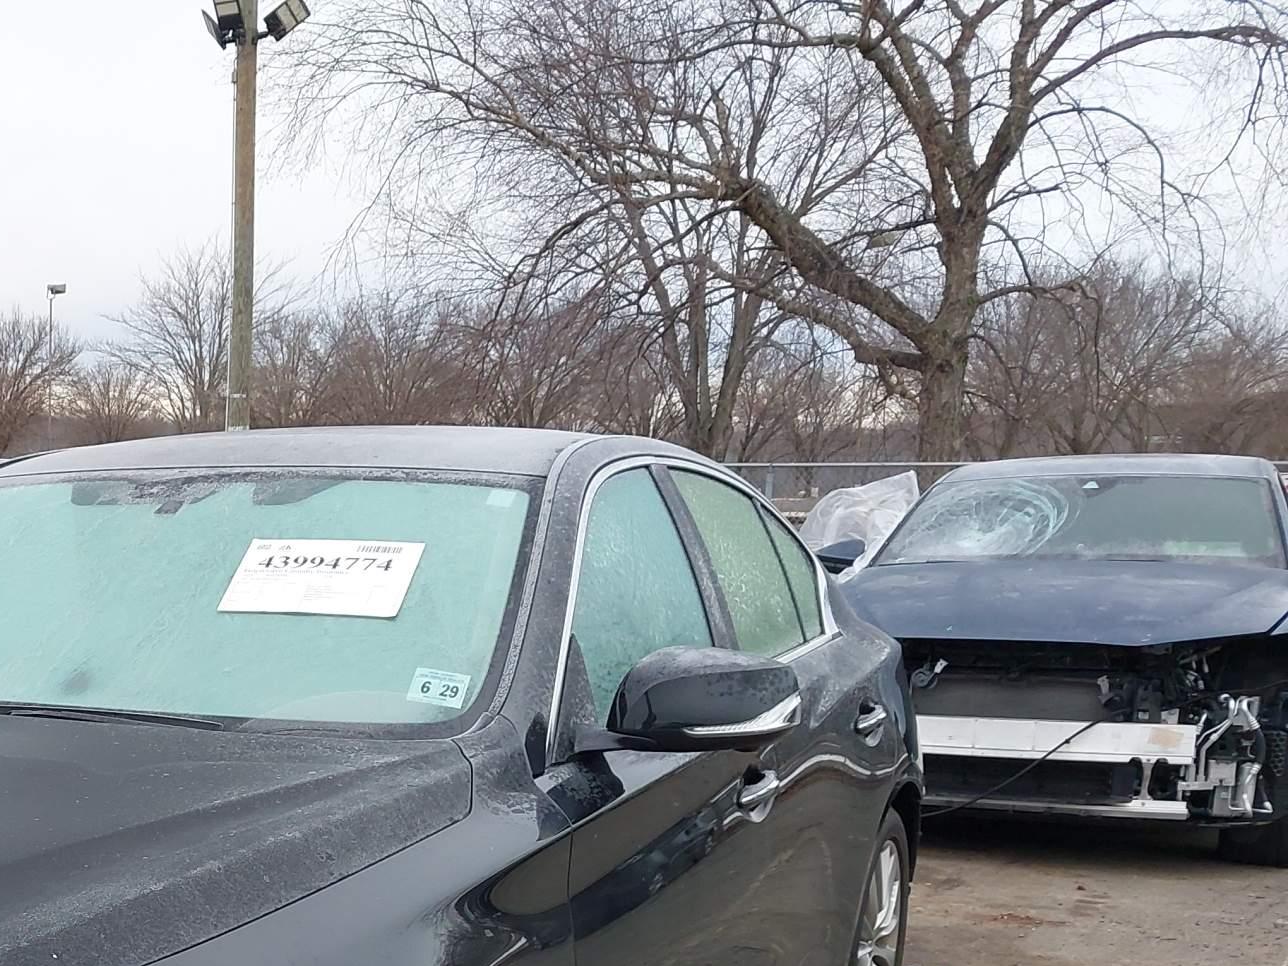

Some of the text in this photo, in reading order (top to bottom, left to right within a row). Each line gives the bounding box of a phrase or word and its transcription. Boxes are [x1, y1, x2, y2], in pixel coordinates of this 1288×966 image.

[257, 555, 393, 572] 43994774
[420, 680, 460, 698] 6 29
